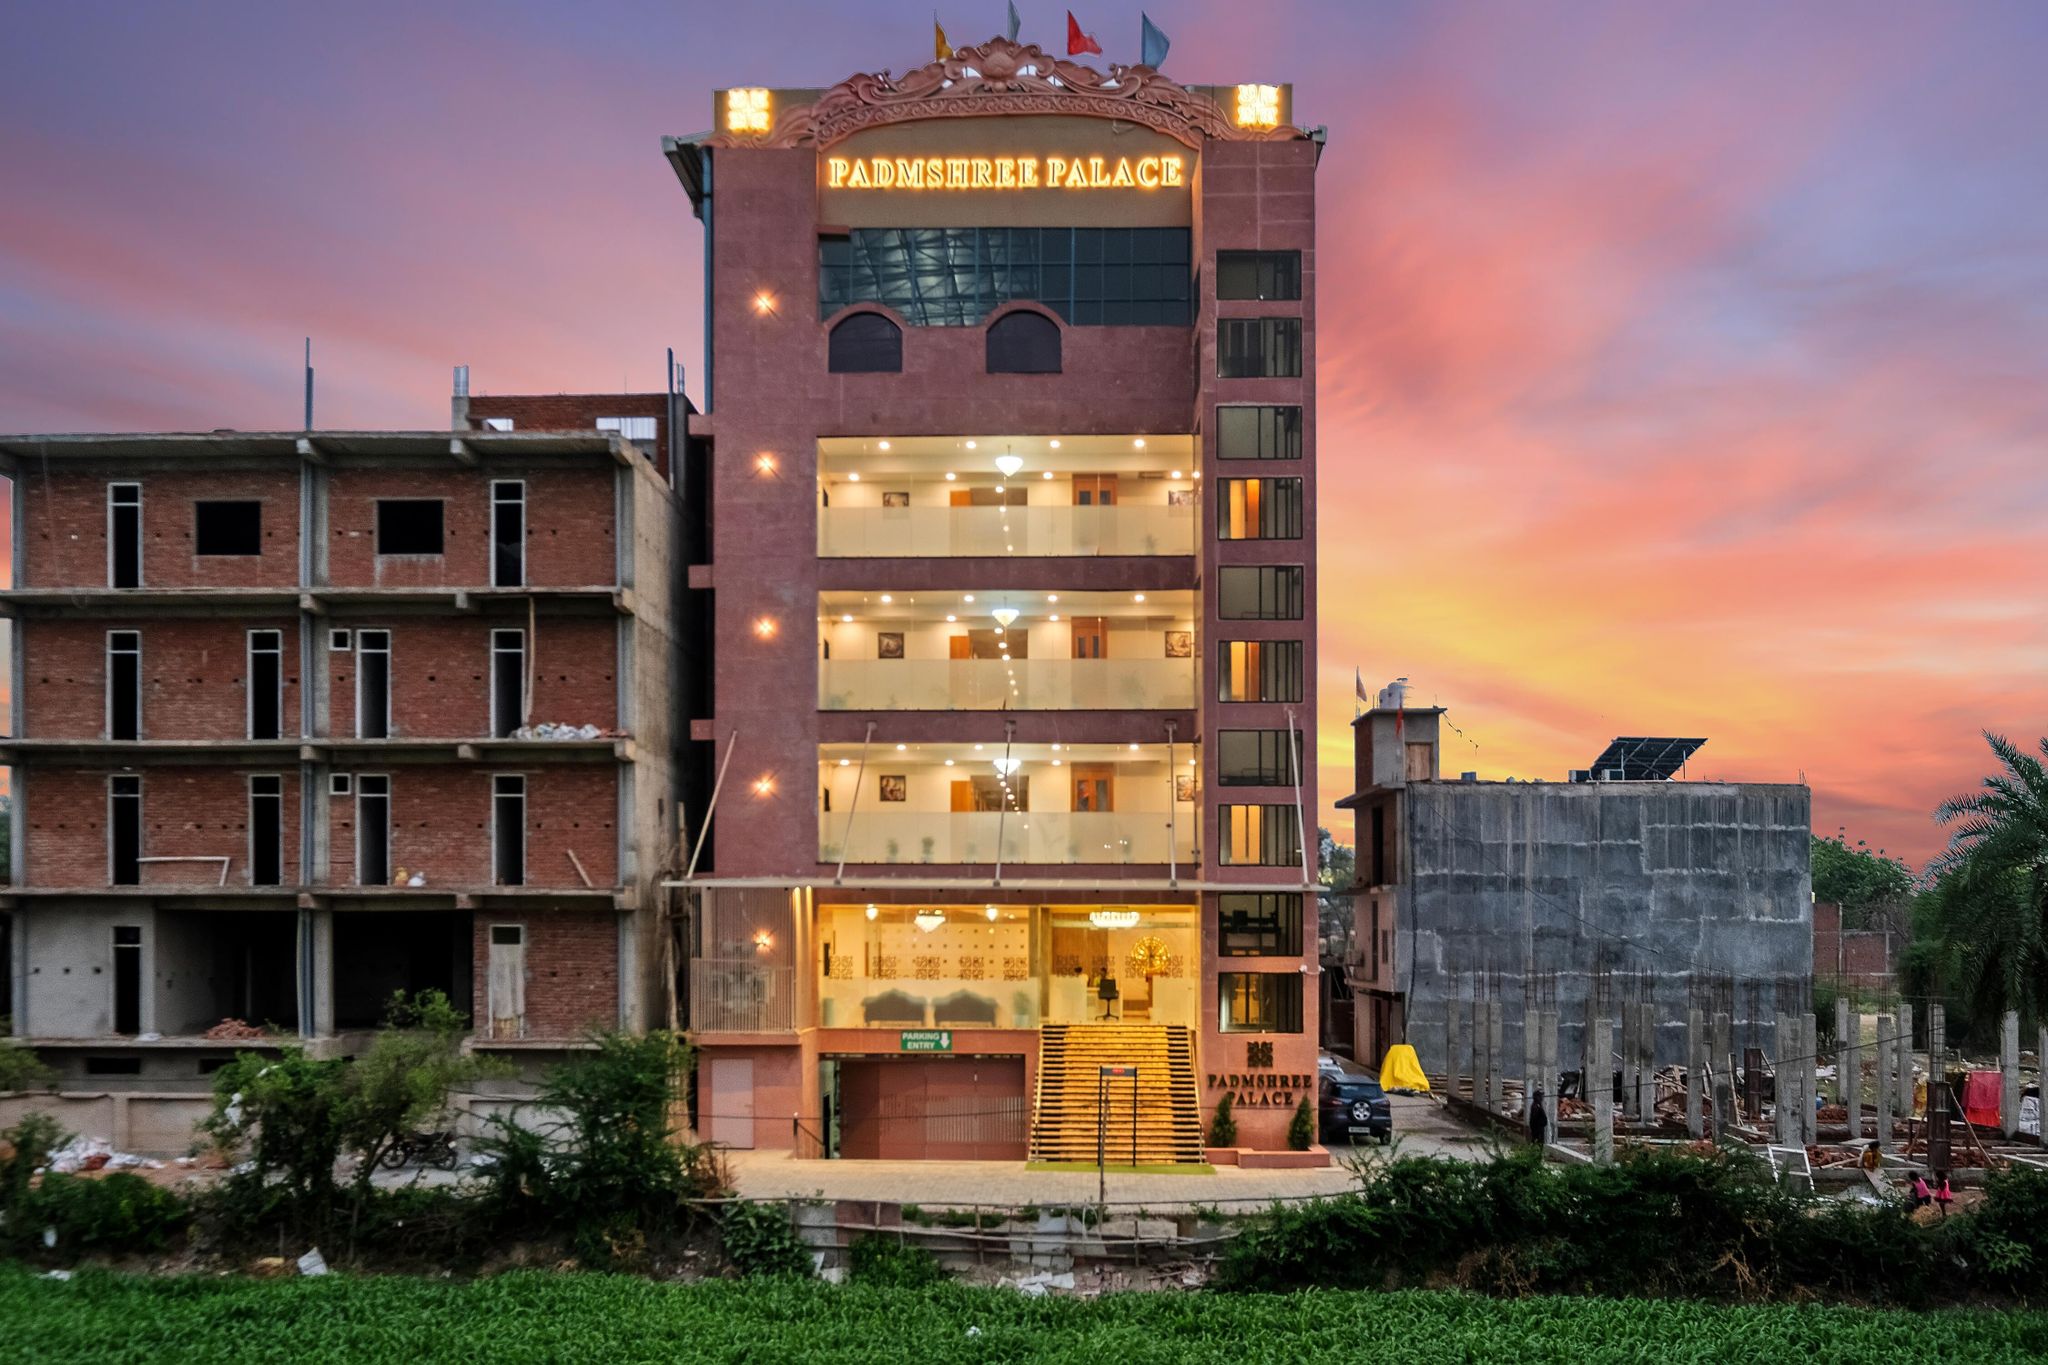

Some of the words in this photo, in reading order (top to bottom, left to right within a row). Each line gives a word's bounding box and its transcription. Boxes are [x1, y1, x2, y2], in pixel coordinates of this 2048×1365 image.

[828, 157, 1039, 188] PADMSHREE
[1046, 156, 1182, 188] PALACE
[902, 1031, 940, 1040] PARKING
[907, 1041, 935, 1049] ENTRY
[1207, 1074, 1312, 1088] PADMSHREE
[1226, 1091, 1293, 1105] PALACE
